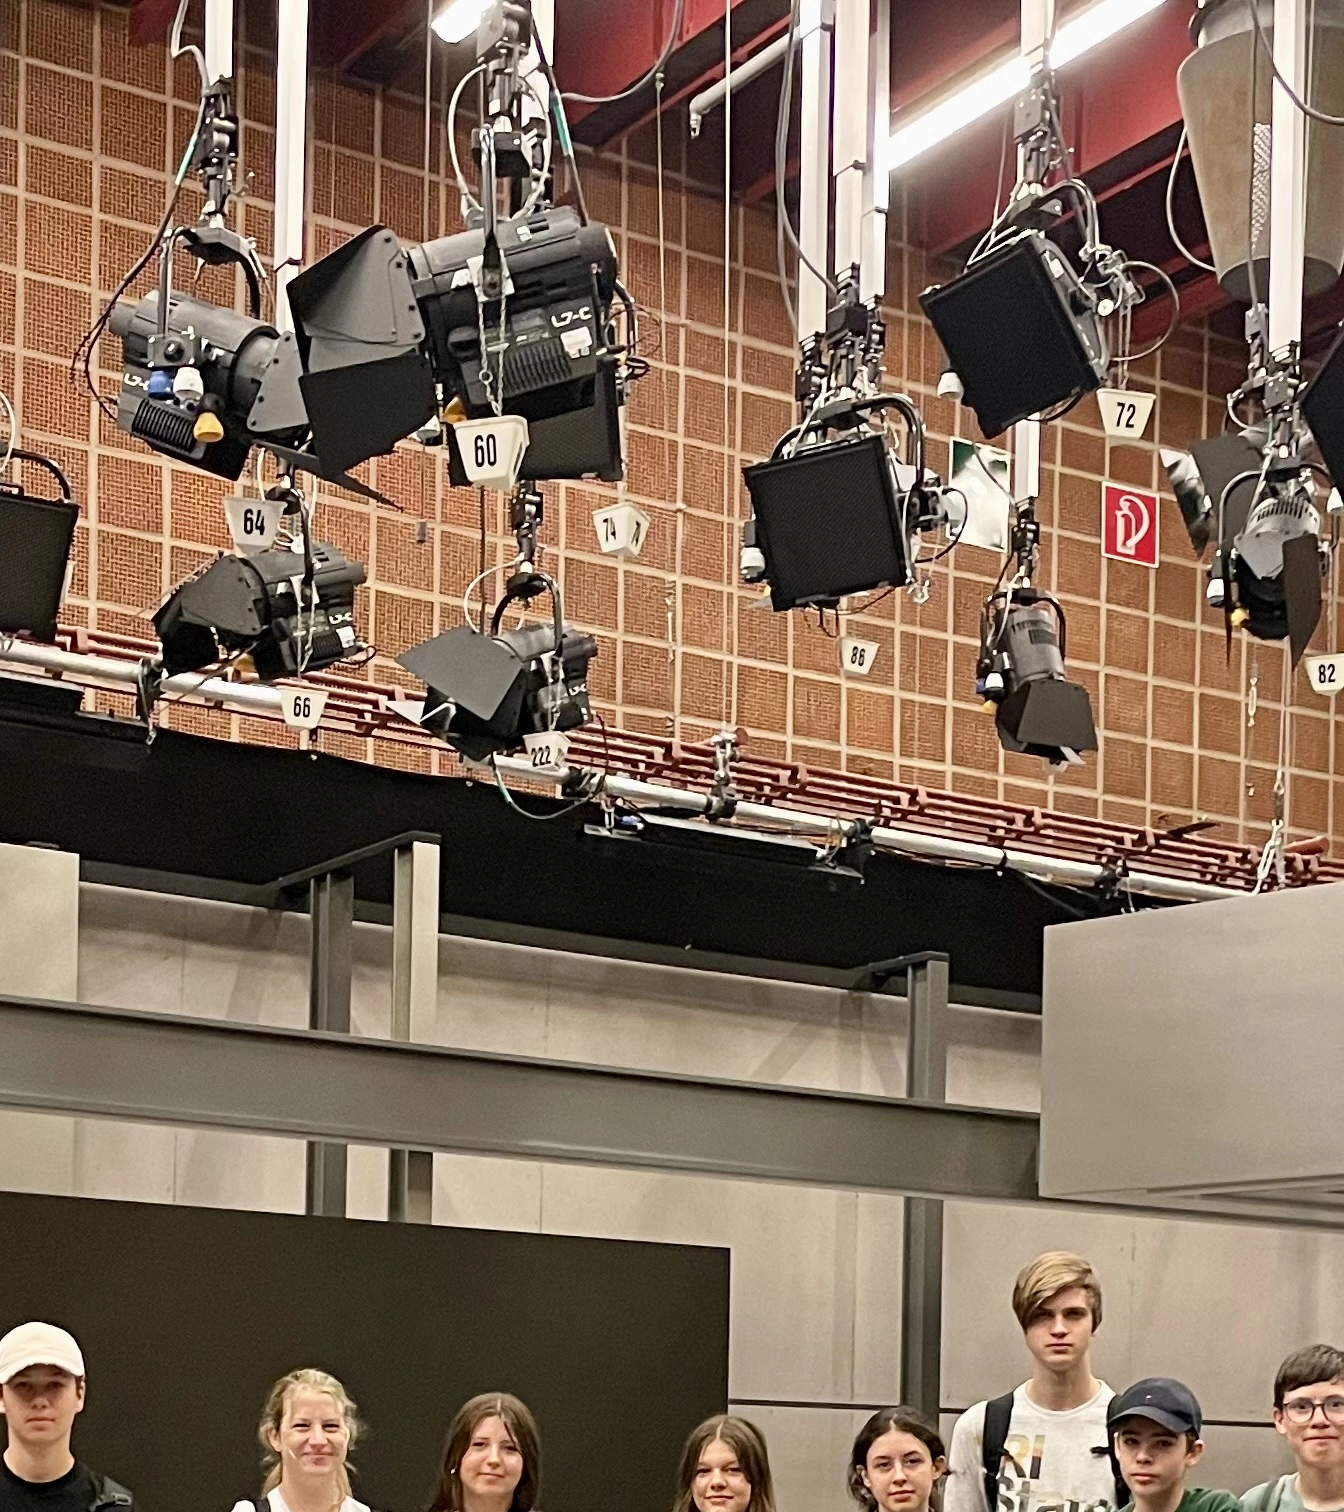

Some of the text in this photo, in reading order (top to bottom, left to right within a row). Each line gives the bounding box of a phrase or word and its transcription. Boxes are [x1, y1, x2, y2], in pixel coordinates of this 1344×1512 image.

[1116, 402, 1136, 428] 72
[475, 433, 497, 467] 60
[243, 508, 265, 535] 64
[602, 517, 617, 543] 74
[1318, 663, 1335, 684] 82
[293, 695, 311, 718] 66
[531, 745, 552, 767] 222
[998, 1434, 1045, 1480] RI
